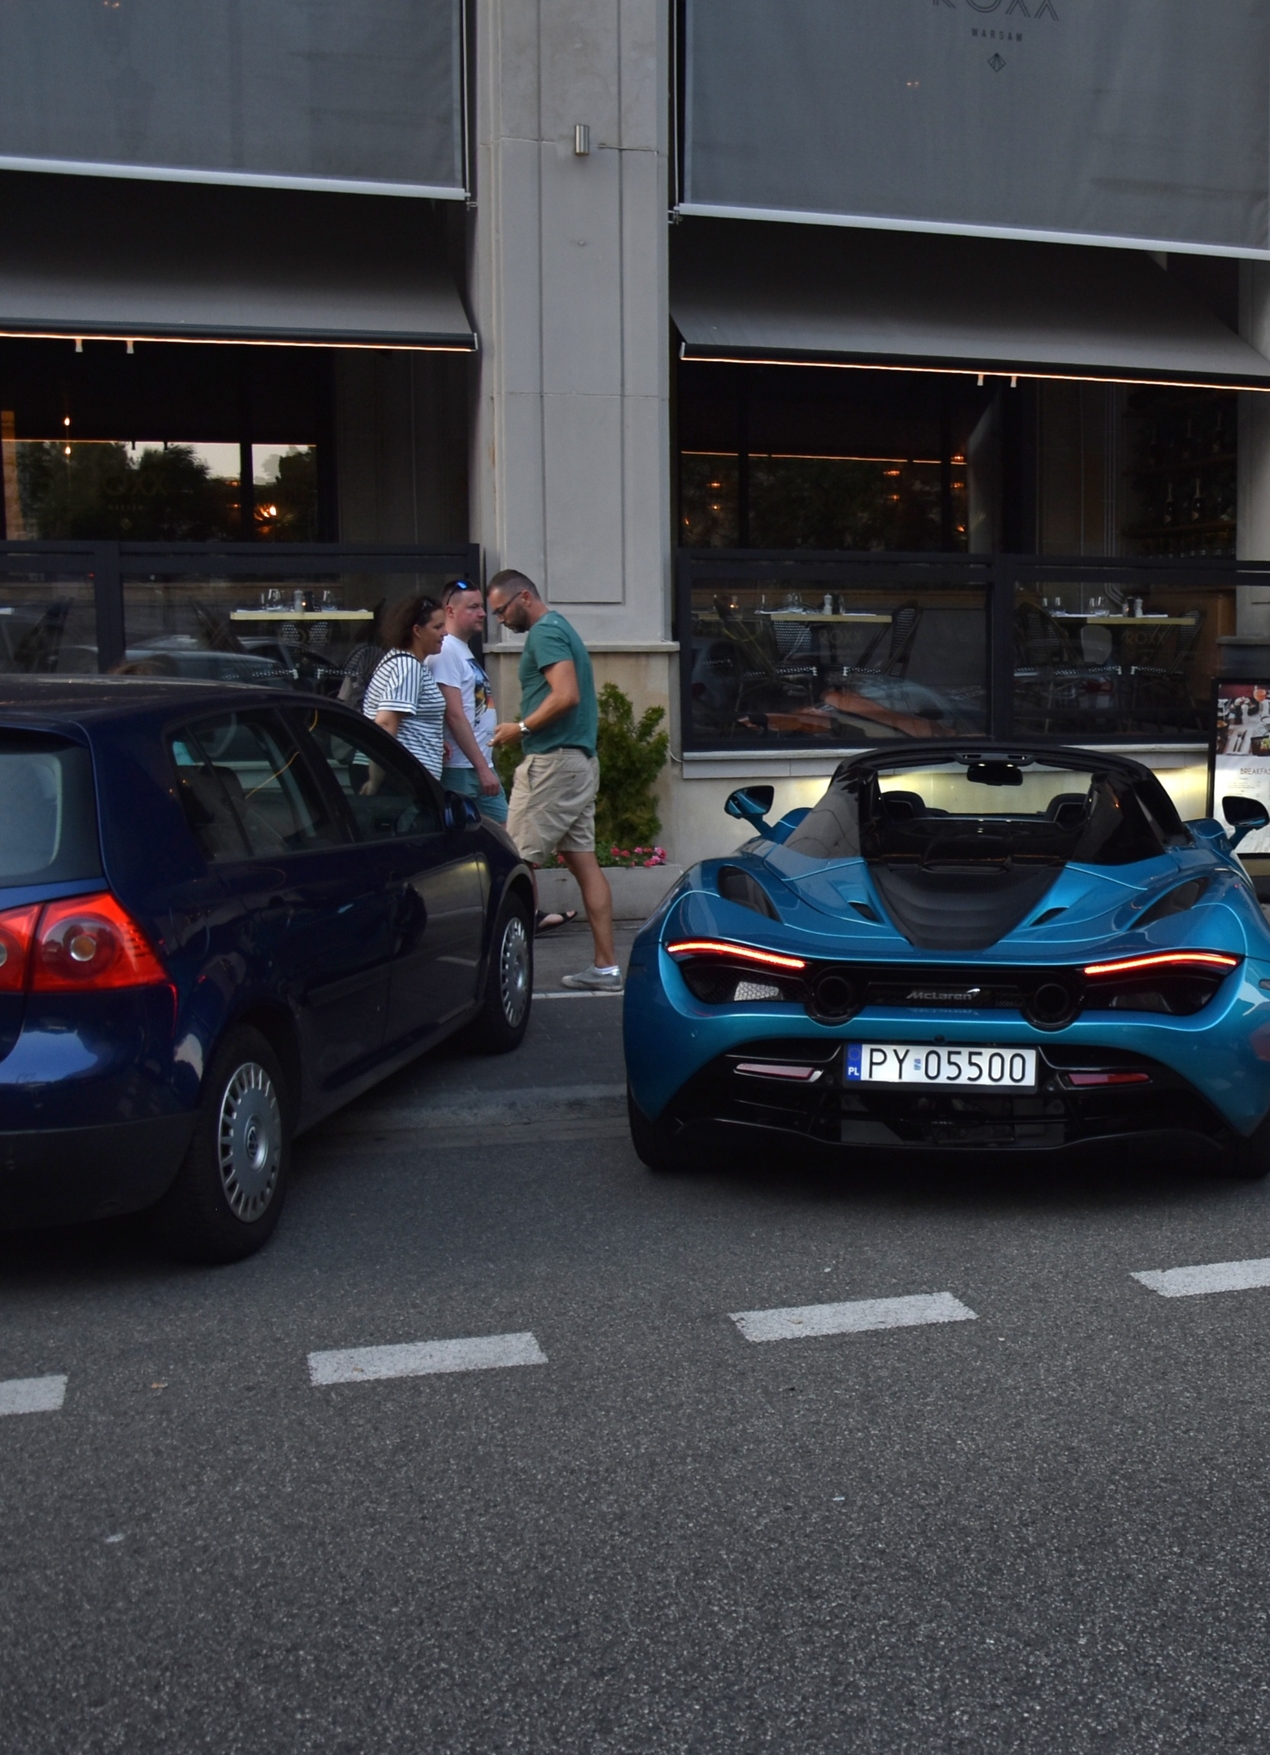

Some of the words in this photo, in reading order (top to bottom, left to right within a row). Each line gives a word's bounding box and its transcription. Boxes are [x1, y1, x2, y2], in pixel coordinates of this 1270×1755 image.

[971, 28, 1023, 42] WARSAW
[906, 990, 973, 1001] McLaren
[848, 1066, 860, 1076] PL
[869, 1048, 910, 1080] PY
[924, 1049, 1026, 1084] 05500
